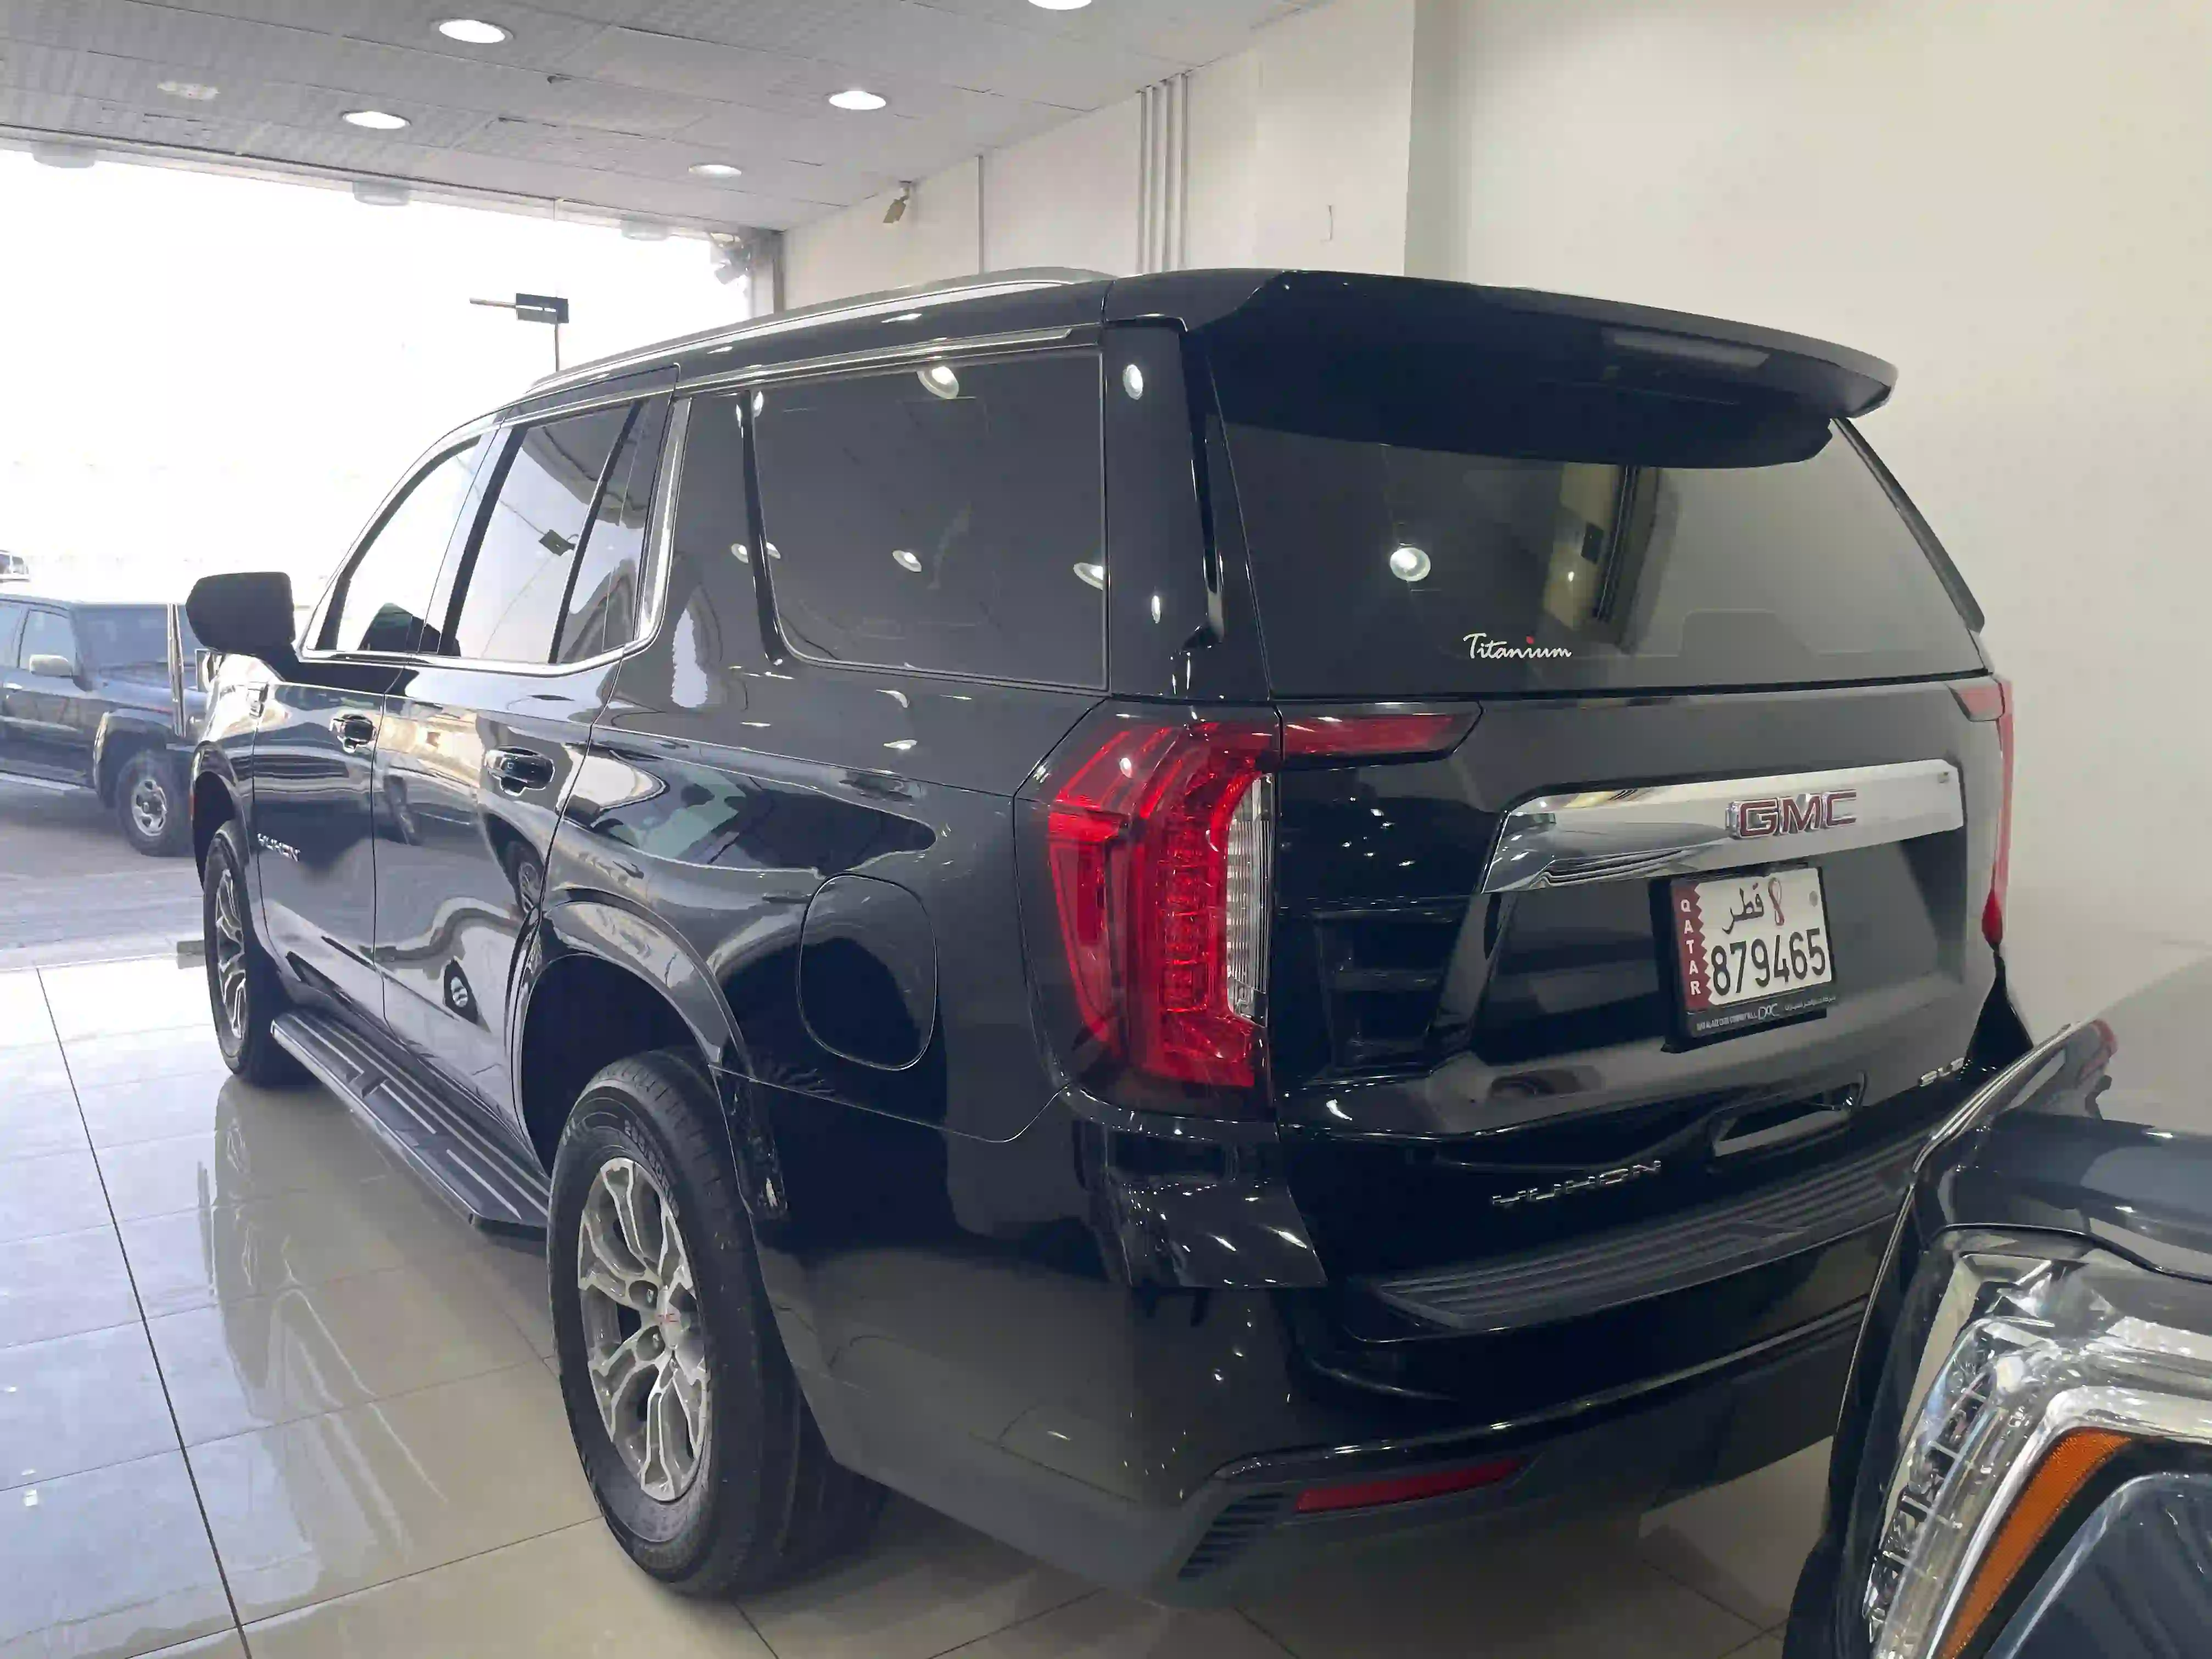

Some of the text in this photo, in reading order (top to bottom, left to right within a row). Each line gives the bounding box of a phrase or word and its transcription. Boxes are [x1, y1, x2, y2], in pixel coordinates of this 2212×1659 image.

[1463, 633, 1572, 659] Titanium
[1727, 789, 1857, 838] GMC
[1722, 882, 1764, 934] قطر
[1680, 899, 1701, 995] QATAR
[1711, 927, 1826, 996] 879465
